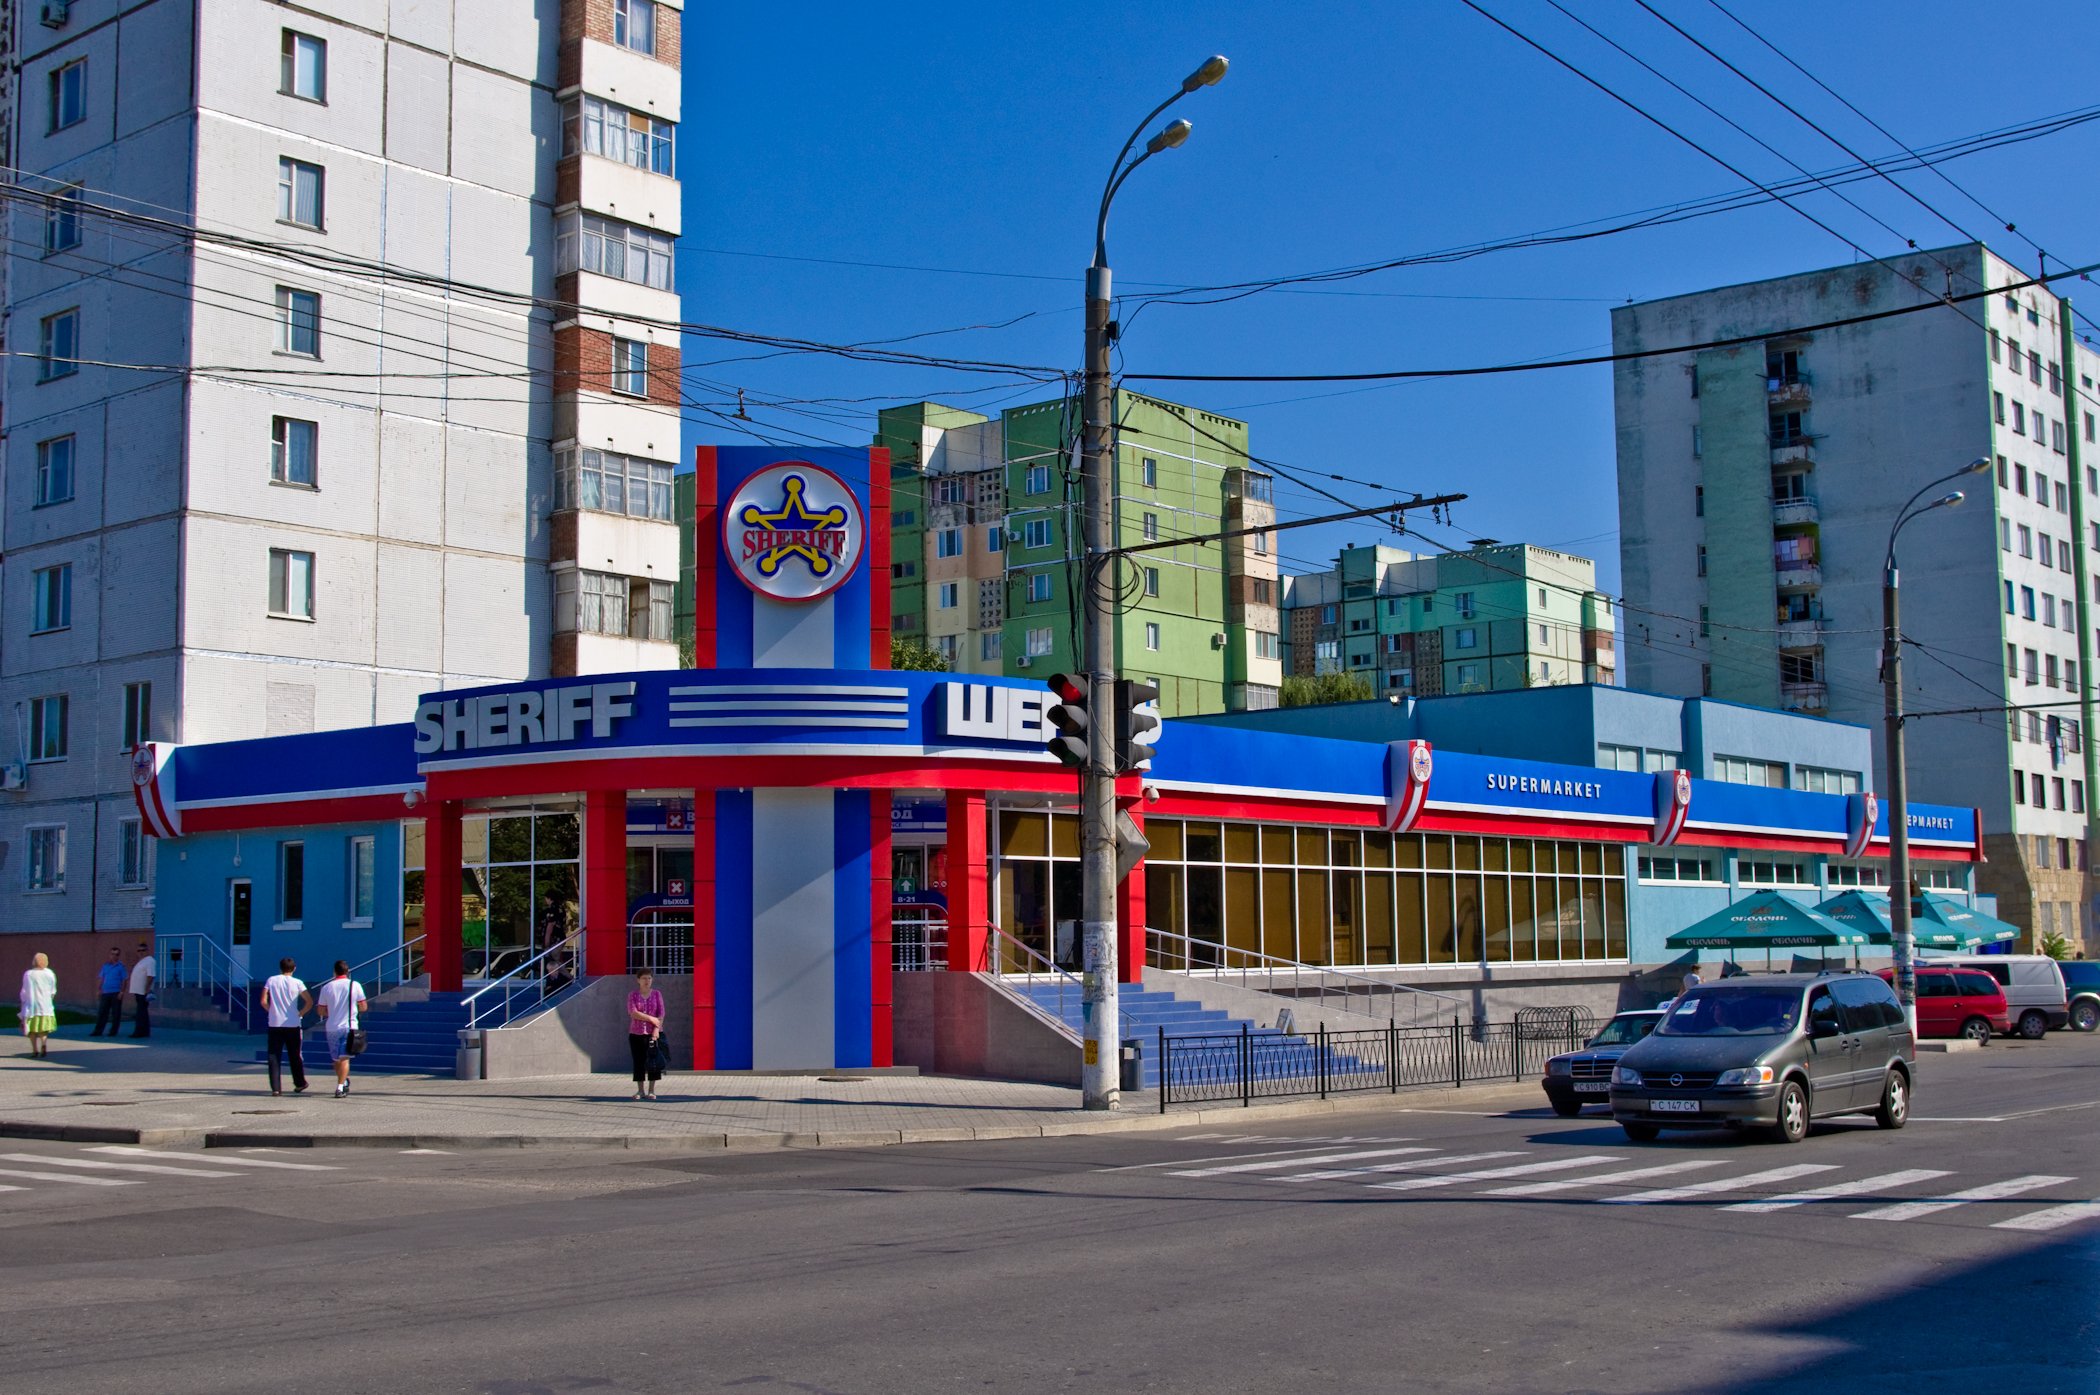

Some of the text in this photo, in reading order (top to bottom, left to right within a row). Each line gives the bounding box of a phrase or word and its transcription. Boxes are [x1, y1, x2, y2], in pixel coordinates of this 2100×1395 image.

[743, 530, 846, 561] SHERIFF
[414, 681, 636, 754] SHERIFF
[1487, 773, 1602, 799] SUPERMARKET
[891, 810, 913, 820] ОД
[1906, 814, 1954, 830] ЕРМАРКЕТ
[1686, 938, 1731, 946] ОБОЛОНЬ
[1771, 936, 1816, 945] ОБОЛОНЬ
[1658, 1101, 1697, 1111] C 147 CK
